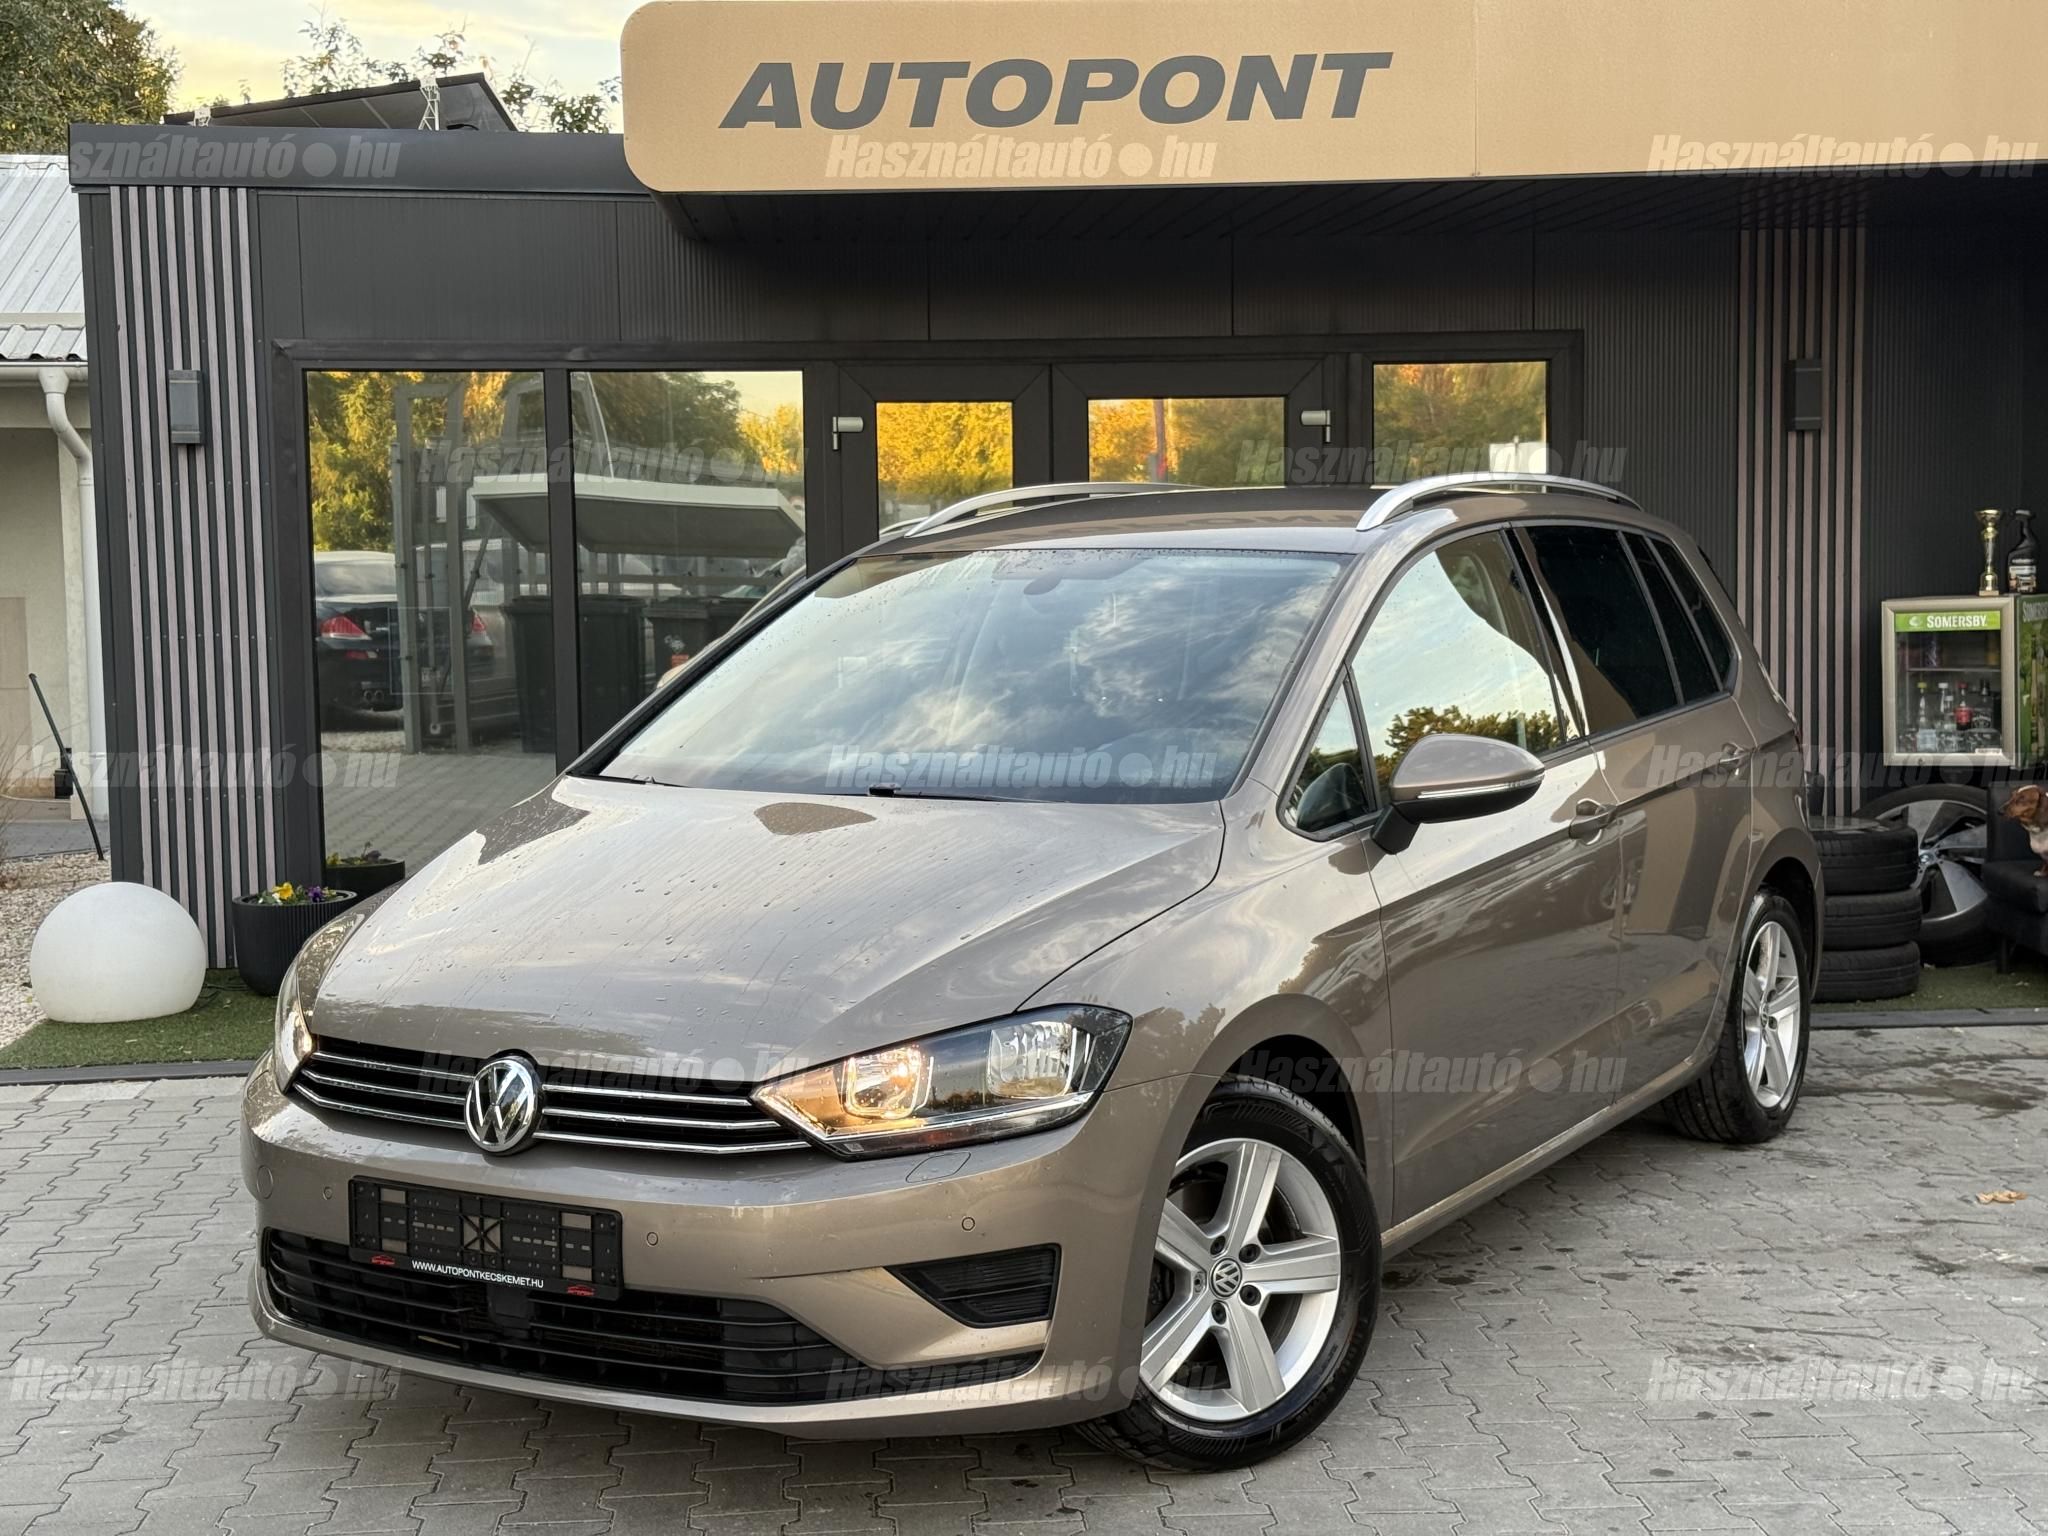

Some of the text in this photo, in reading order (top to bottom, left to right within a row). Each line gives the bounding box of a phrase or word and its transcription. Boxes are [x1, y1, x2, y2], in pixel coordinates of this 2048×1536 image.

[718, 52, 1394, 130] AUTOPONT
[1926, 614, 1987, 629] SOMERSBY
[411, 1260, 544, 1288] WWW.AUTOPONTKECSKEMET.HU
